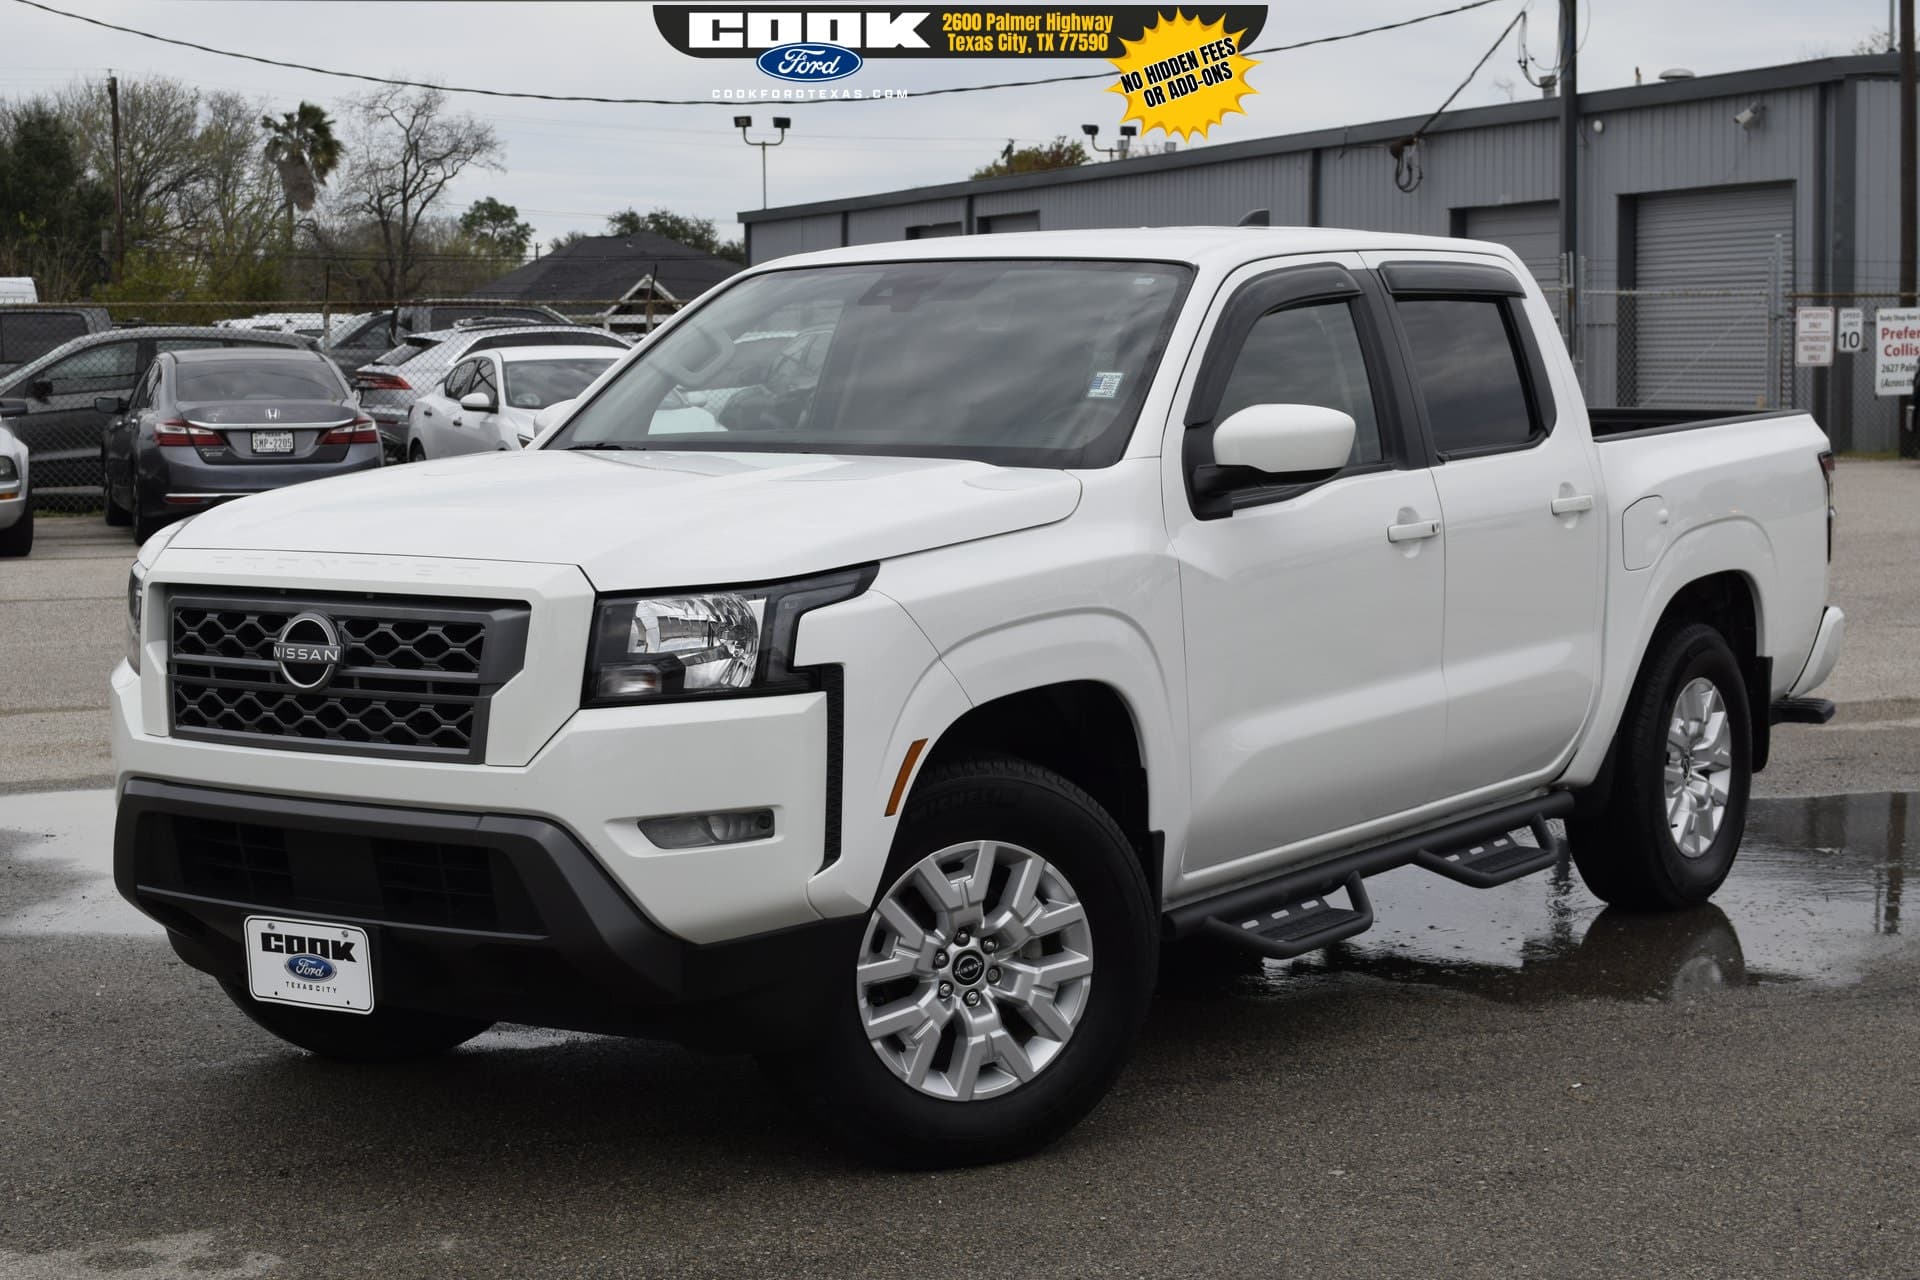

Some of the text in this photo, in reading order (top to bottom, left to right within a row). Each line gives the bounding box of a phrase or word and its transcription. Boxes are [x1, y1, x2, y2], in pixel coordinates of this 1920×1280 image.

[1841, 331, 1860, 349] 10
[273, 646, 338, 661] NISSAN
[261, 932, 358, 963] COOK
[295, 958, 325, 977] Ford
